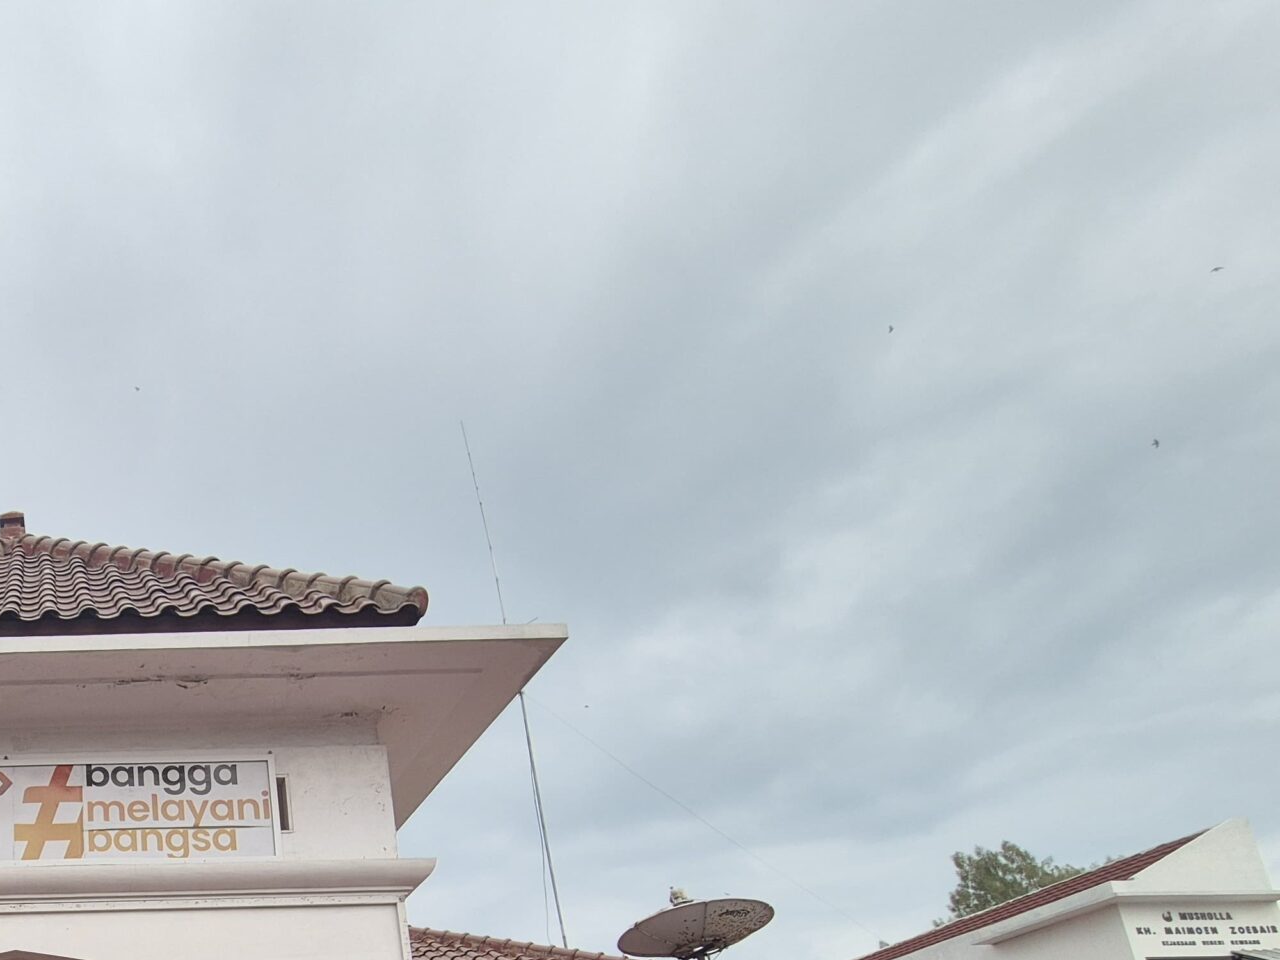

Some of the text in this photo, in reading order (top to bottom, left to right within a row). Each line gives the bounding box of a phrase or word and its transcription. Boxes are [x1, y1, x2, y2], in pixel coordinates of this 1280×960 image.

[86, 763, 238, 795] bangga
[87, 790, 271, 827] melayani
[88, 828, 238, 858] bangsa
[1164, 926, 1219, 936] MAIMOEN
[1229, 925, 1279, 935] ZOEBAIR
[1178, 912, 1233, 921] MUSHOLLA
